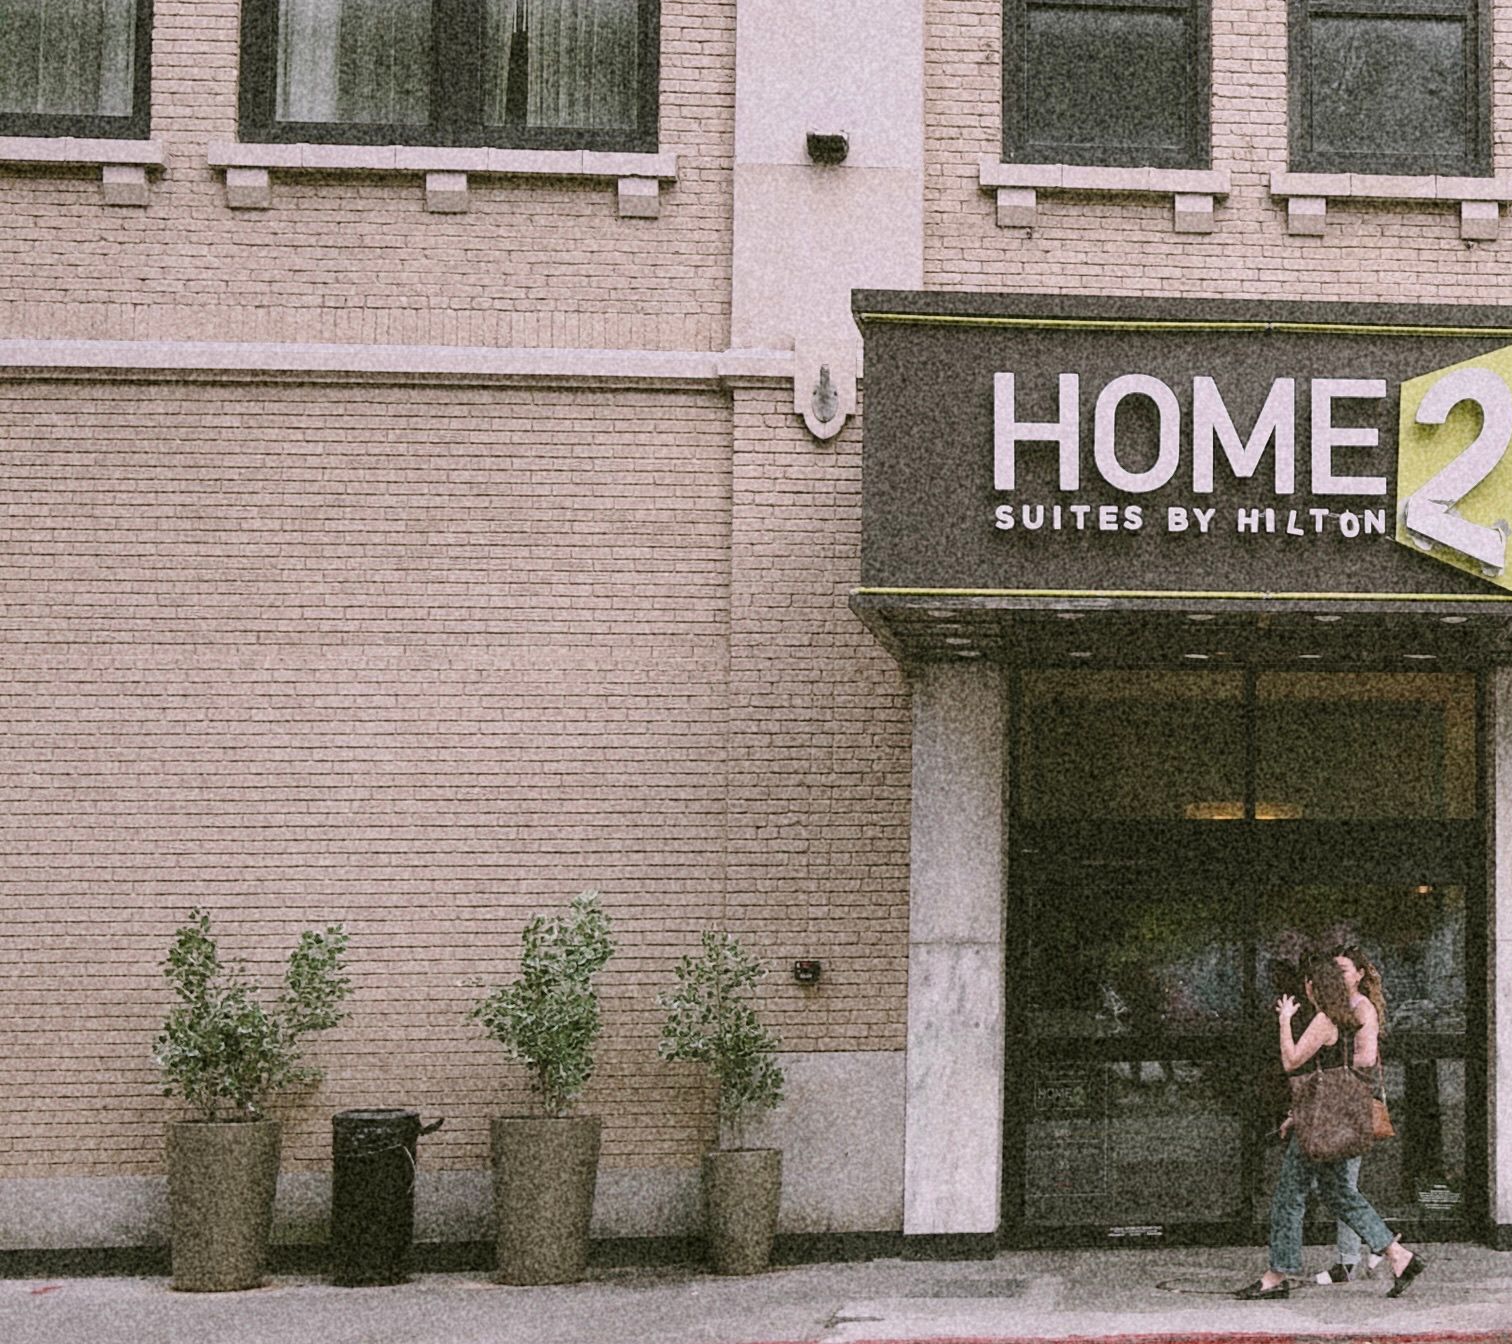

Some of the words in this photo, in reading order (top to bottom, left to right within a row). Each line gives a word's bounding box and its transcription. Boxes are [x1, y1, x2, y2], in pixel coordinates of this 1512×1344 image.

[995, 505, 1143, 532] SUITES
[1168, 506, 1216, 533] BY
[1238, 508, 1386, 538] HILTON
